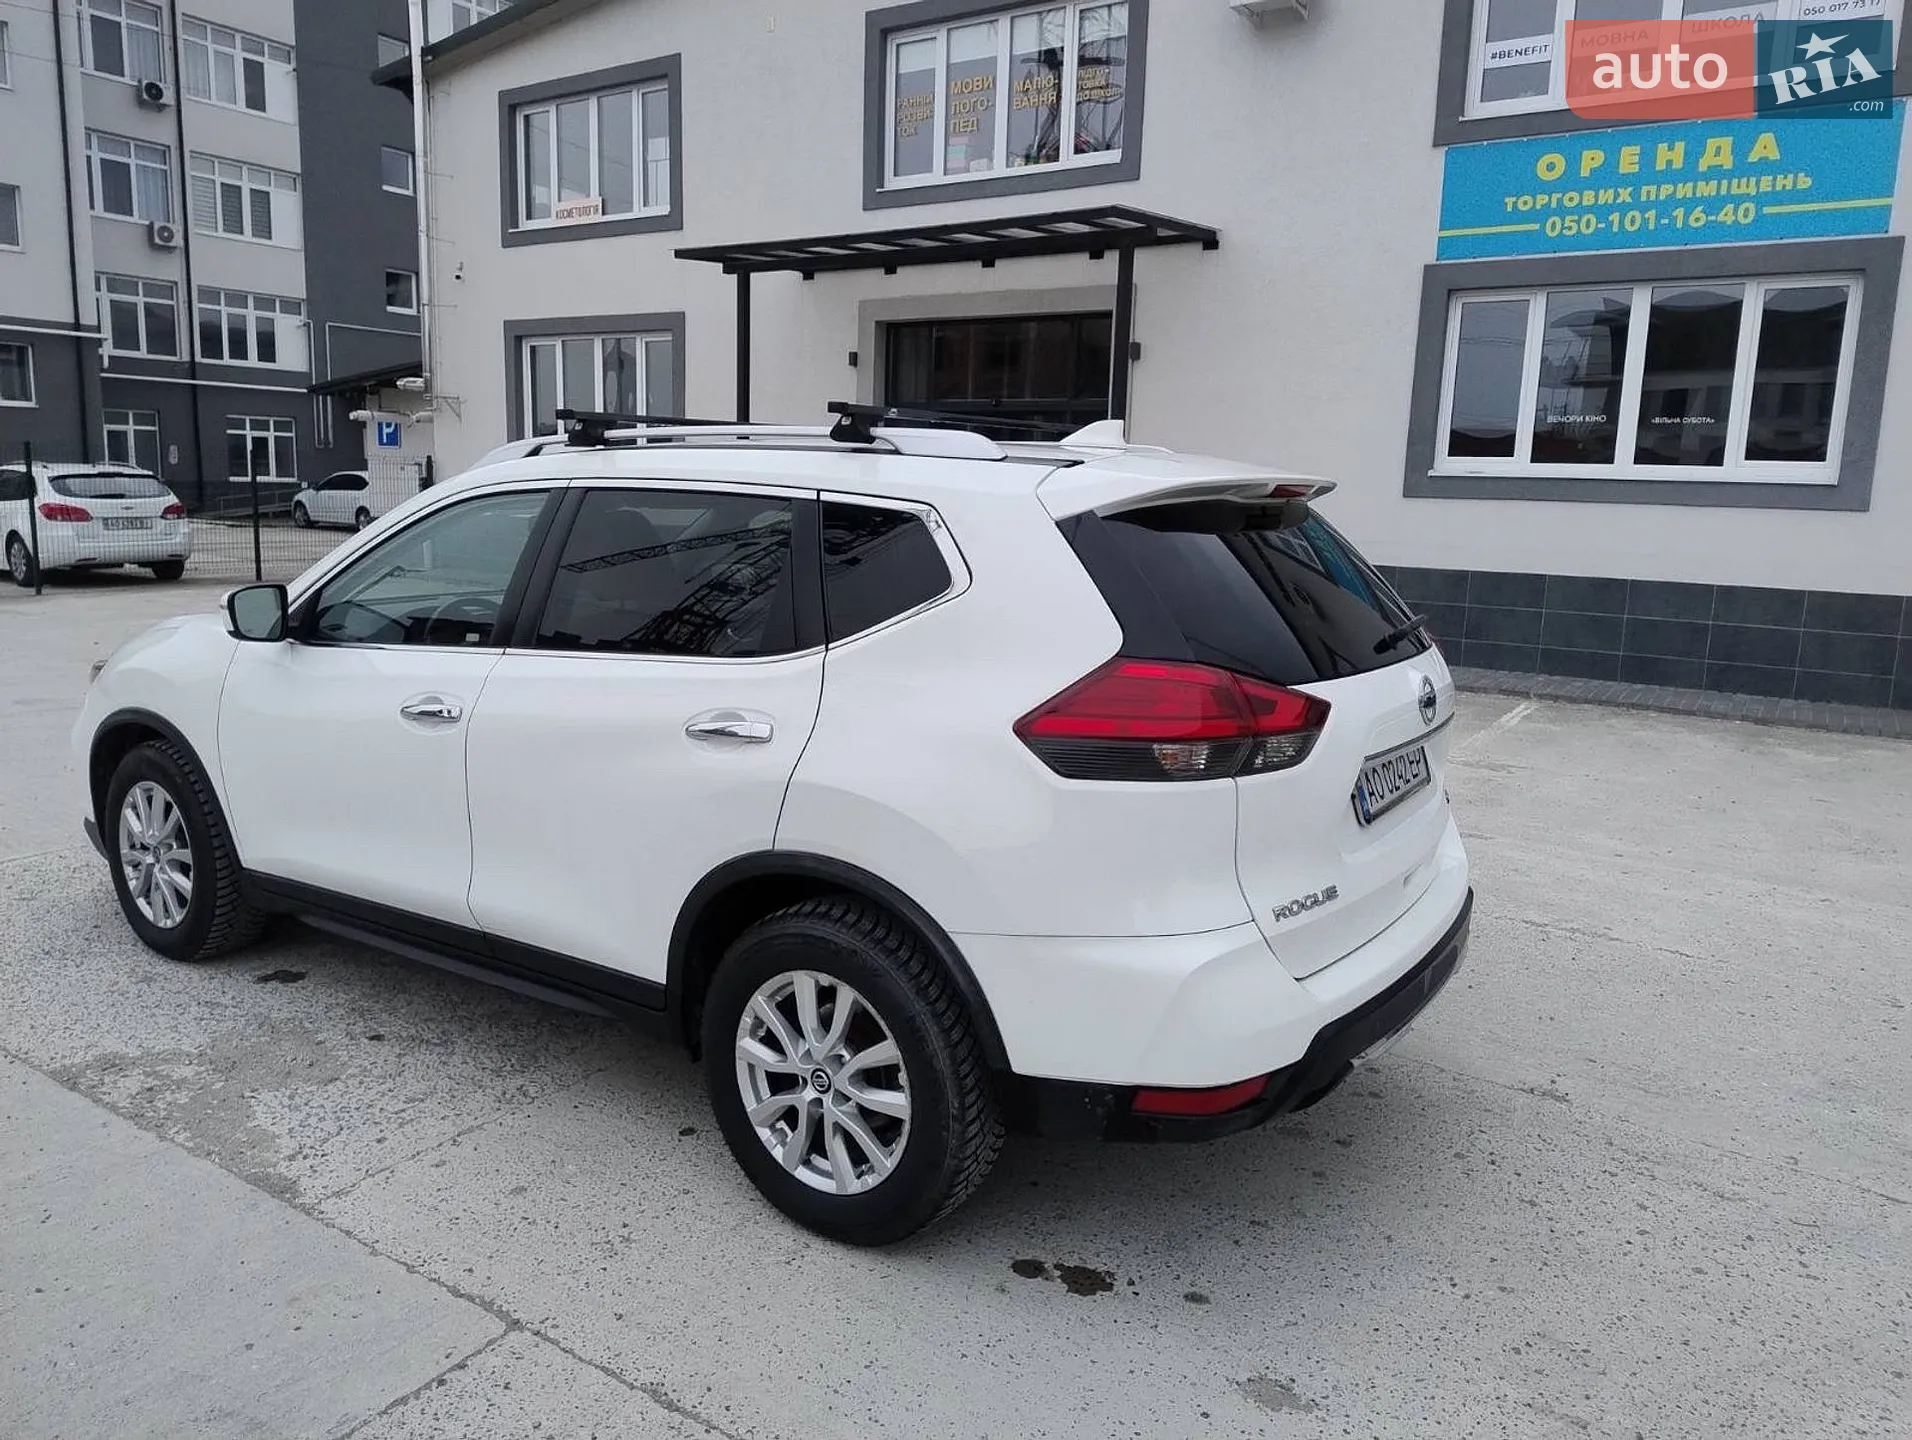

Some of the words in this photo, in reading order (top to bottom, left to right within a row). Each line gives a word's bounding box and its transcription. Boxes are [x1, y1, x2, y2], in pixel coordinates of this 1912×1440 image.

[1803, 6, 1826, 16] 050
[1829, 2, 1849, 12] 017
[1691, 12, 1766, 33] ШКОЛА
[1580, 29, 1649, 48] МОВНА
[1491, 44, 1550, 60] #BENEFIT
[950, 75, 995, 95] МОВИ
[1013, 90, 1058, 109] ВАННЯ
[950, 117, 979, 134] ПЕД
[1536, 131, 1781, 182] ОРЕНДА
[1504, 186, 1634, 212] ТОРГОВИХ
[1640, 172, 1813, 202] ПРИМІЩЕНЬ
[1545, 201, 1756, 237] 050-101-16-40
[382, 421, 395, 443] P
[1364, 766, 1384, 807] AO
[1272, 884, 1340, 922] ROGUE
